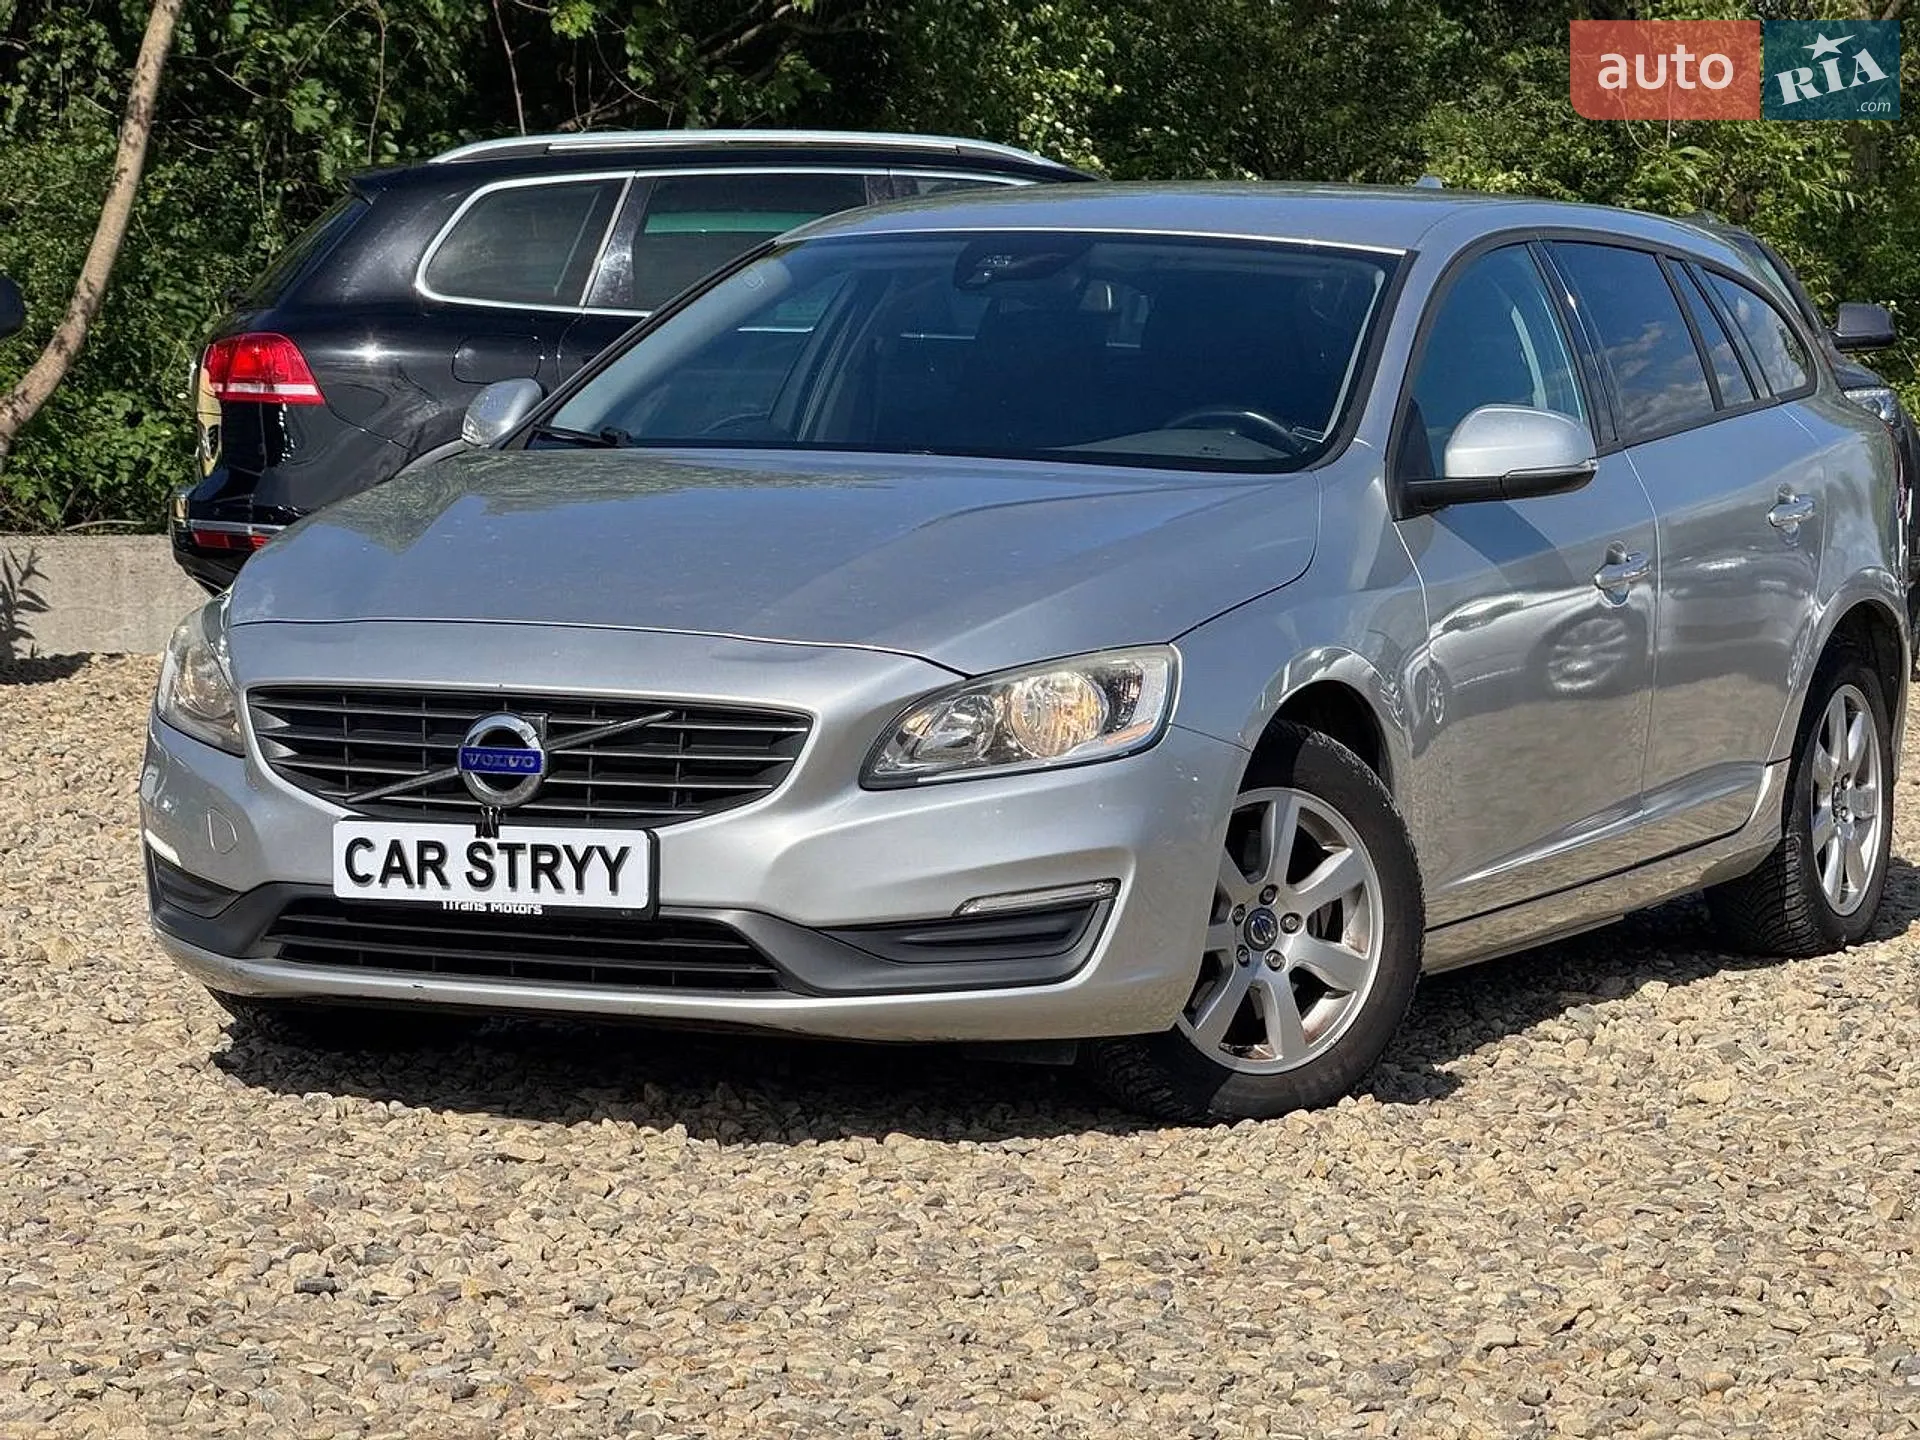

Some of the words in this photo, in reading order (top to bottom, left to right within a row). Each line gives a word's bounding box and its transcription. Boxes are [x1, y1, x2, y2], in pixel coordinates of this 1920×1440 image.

[464, 752, 536, 769] VOLVO
[345, 837, 449, 888] CAR
[465, 841, 631, 895] STRYY
[490, 901, 543, 915] Motors
